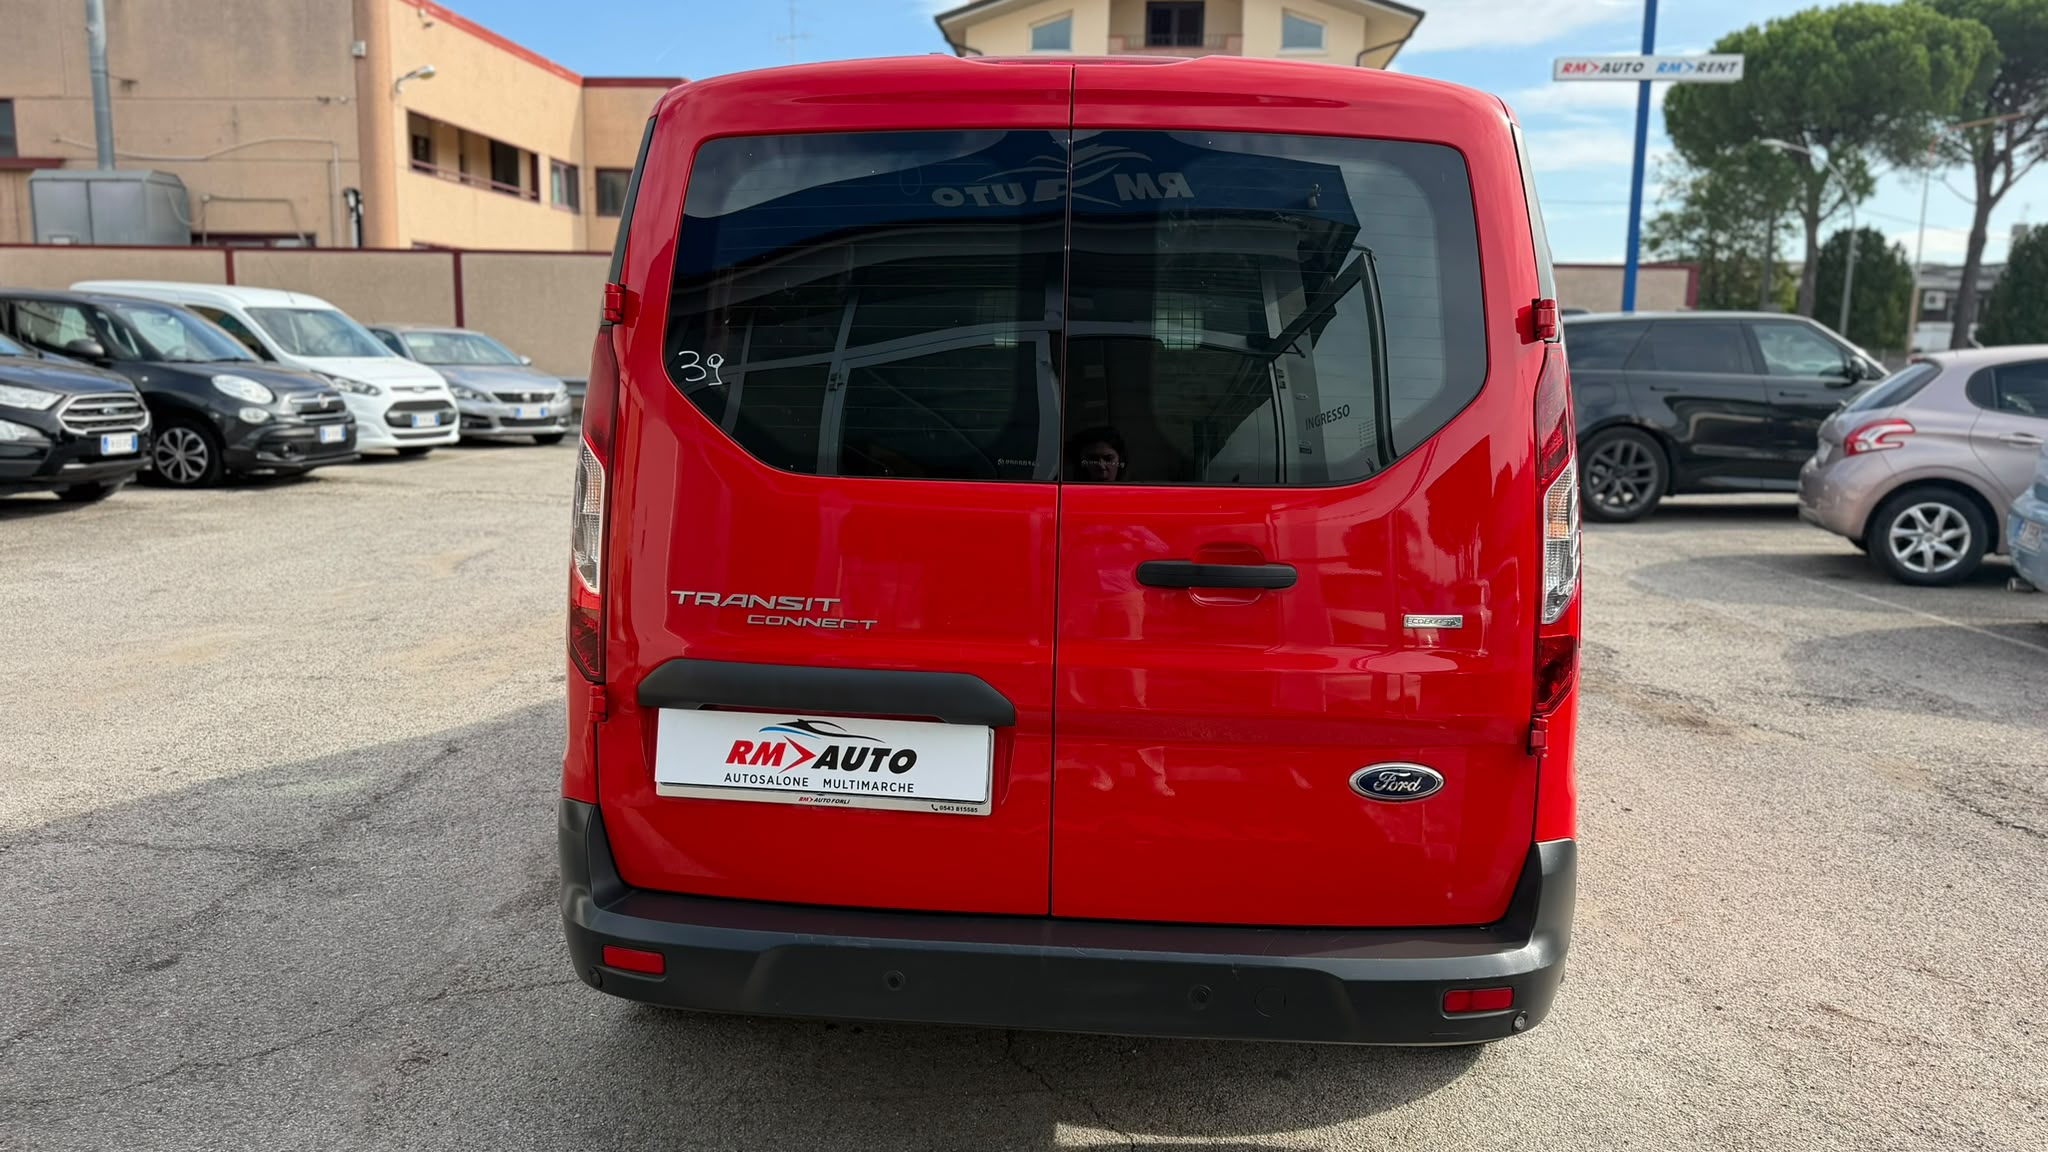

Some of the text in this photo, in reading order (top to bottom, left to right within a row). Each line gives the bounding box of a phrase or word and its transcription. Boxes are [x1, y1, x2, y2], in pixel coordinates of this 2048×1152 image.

[1600, 62, 1645, 73] AUTO
[1696, 62, 1738, 73] RENT
[678, 350, 725, 386] 39
[1305, 404, 1350, 431] INGRESSO
[670, 590, 841, 612] TRANSIT
[747, 614, 878, 630] CONNECT
[811, 745, 918, 774] AUTO
[724, 773, 914, 793] AUTOSALONE MULTIMARCHE
[1373, 771, 1422, 792] Ford
